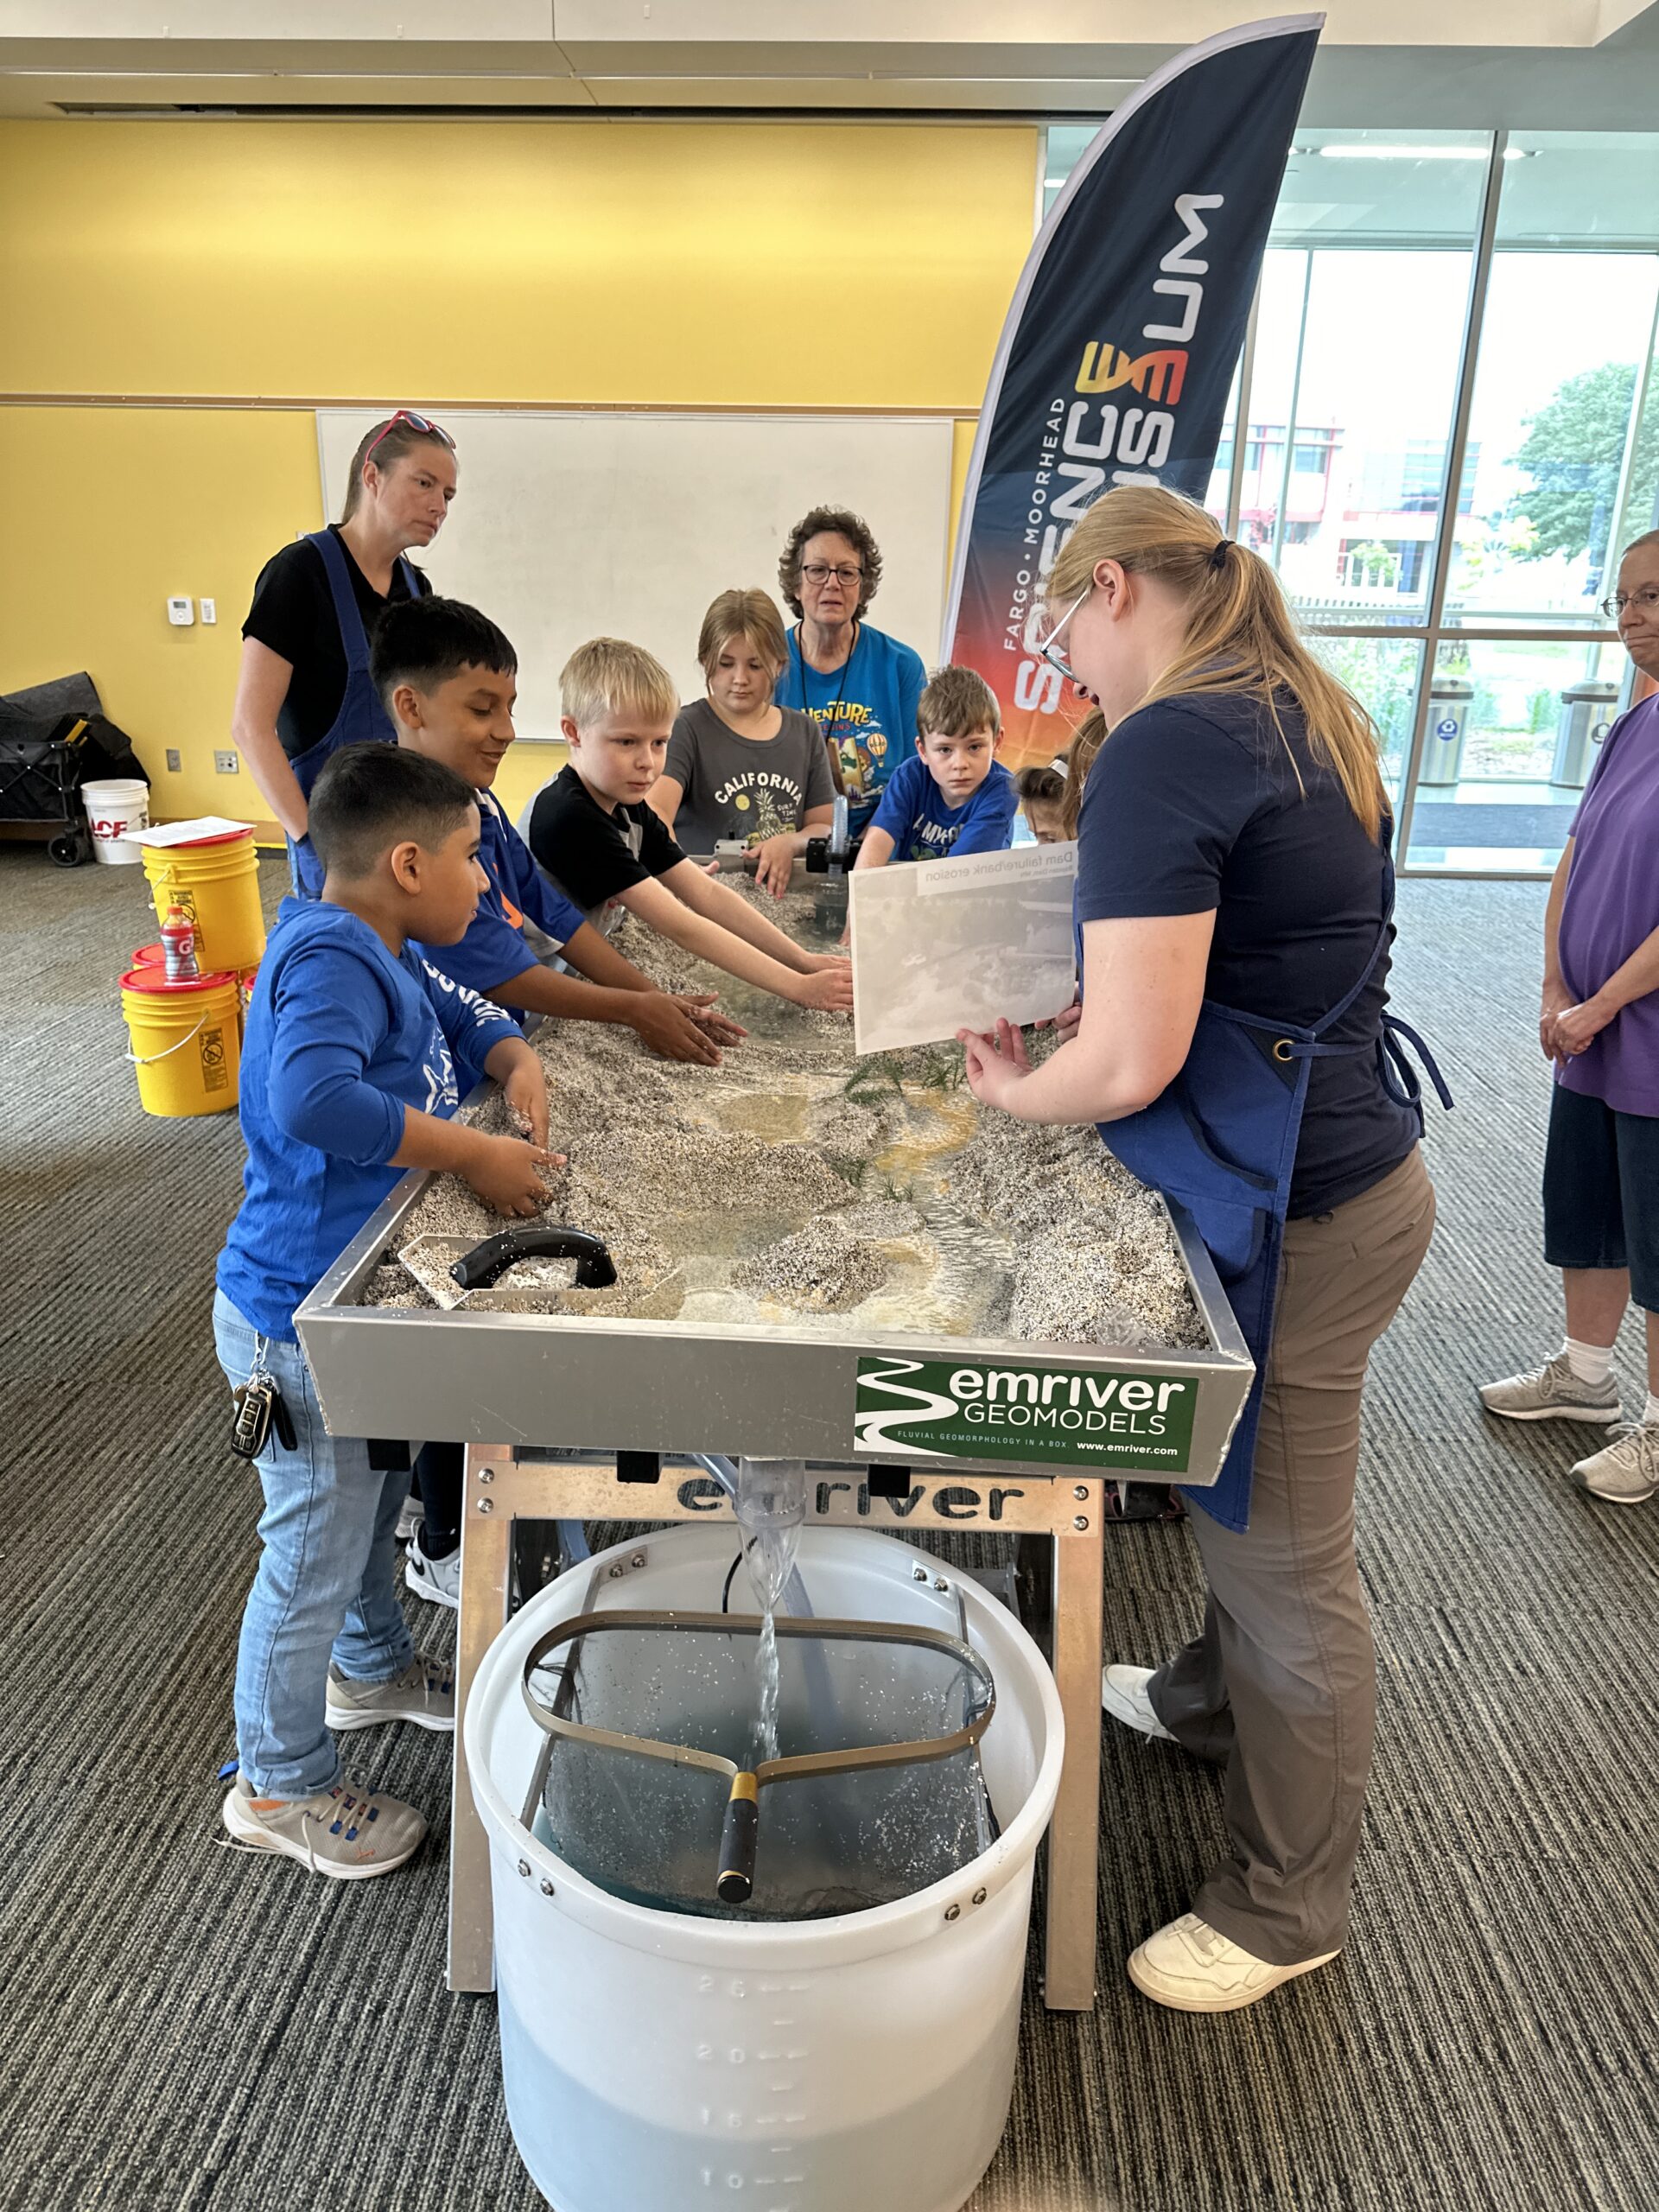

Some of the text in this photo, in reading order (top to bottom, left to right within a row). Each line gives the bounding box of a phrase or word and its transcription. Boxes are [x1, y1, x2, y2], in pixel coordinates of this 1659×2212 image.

[1111, 194, 1224, 486] SEUM
[1004, 397, 1065, 651] FARGO MOORHEAD
[1014, 340, 1132, 715] SCNCE
[715, 772, 803, 806] CALIFORNIA
[950, 1369, 1185, 1412] emriver
[897, 1430, 935, 1440] FLUVIAL
[939, 1433, 1020, 1445] GEOMORPHOLOGY
[963, 1402, 1166, 1435] GEOMODELS
[1077, 1441, 1179, 1456] www.emriver.com
[677, 1478, 1025, 1521] eriver
